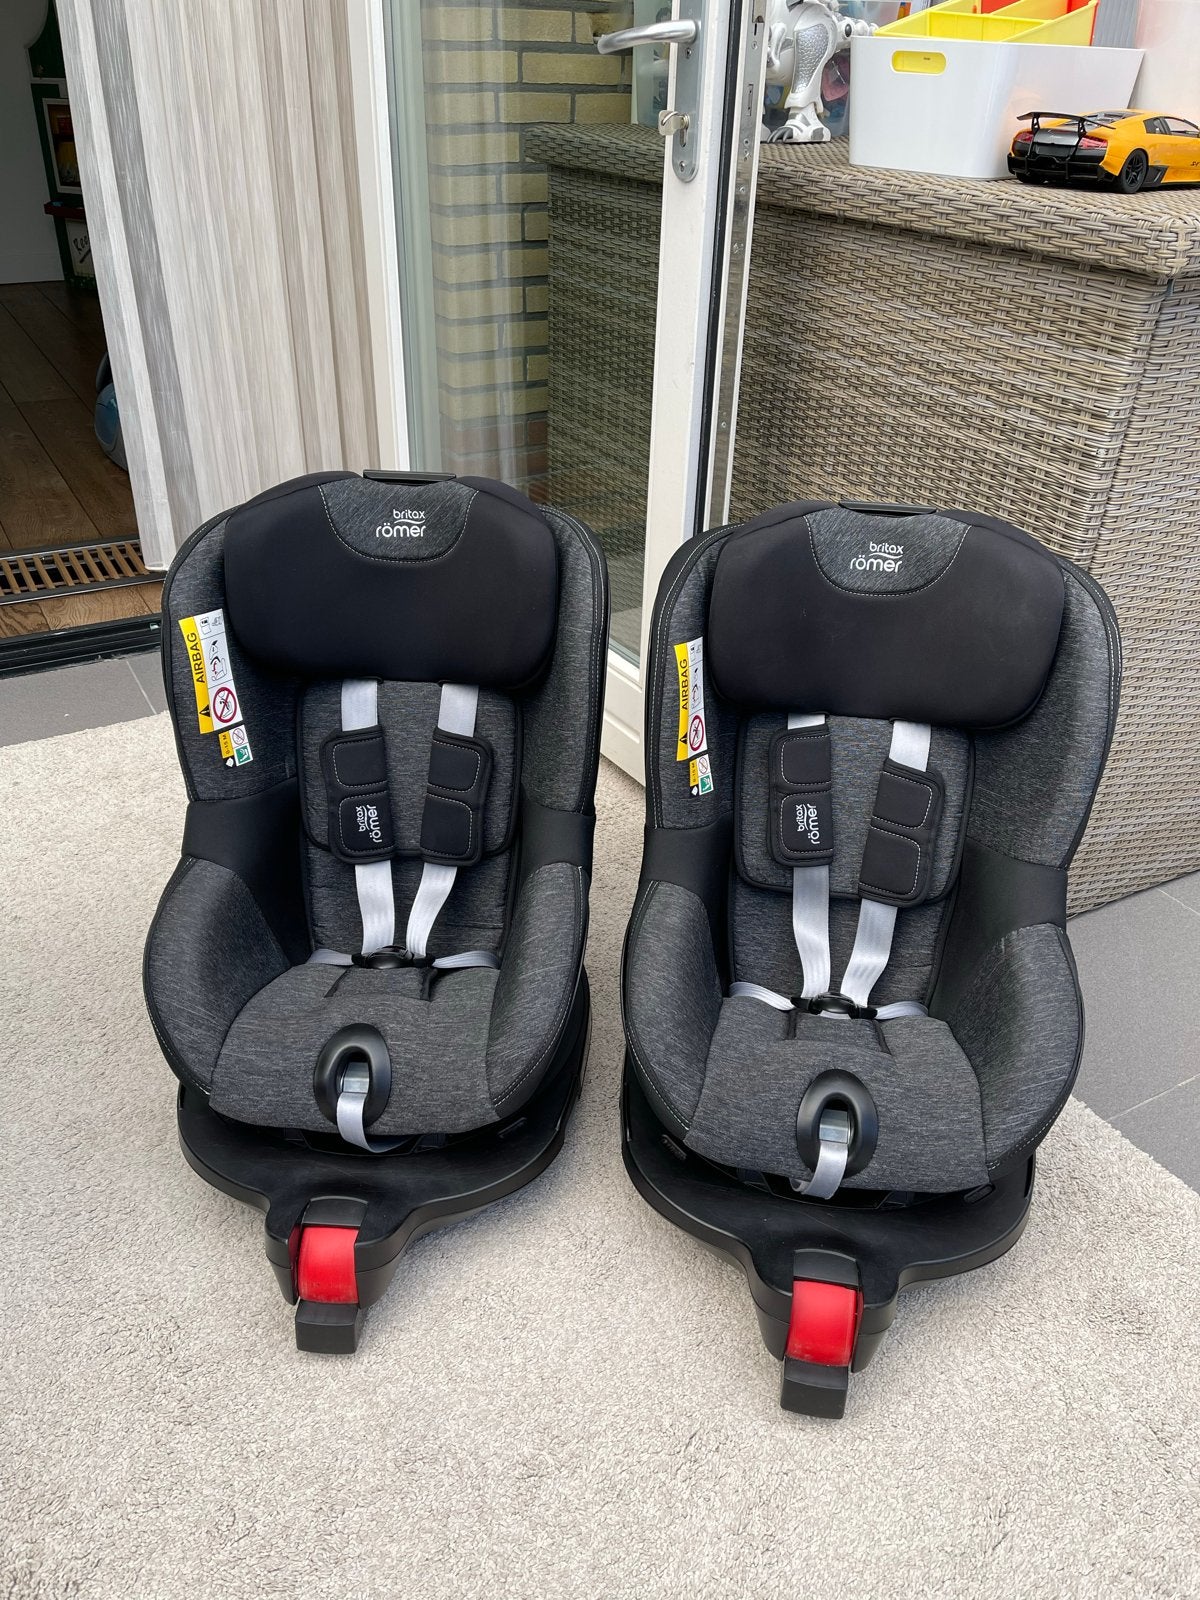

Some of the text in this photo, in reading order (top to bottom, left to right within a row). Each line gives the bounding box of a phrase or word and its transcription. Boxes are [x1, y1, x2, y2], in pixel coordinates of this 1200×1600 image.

[393, 509, 425, 518] britax
[376, 523, 426, 537] römer
[870, 541, 904, 554] britax
[850, 555, 902, 572] römer
[187, 633, 205, 683] AIRBAG
[680, 659, 688, 710] AIRBAG
[356, 806, 366, 831] britax
[367, 805, 382, 842] römer
[796, 804, 804, 831] britax
[807, 804, 820, 844] römer
